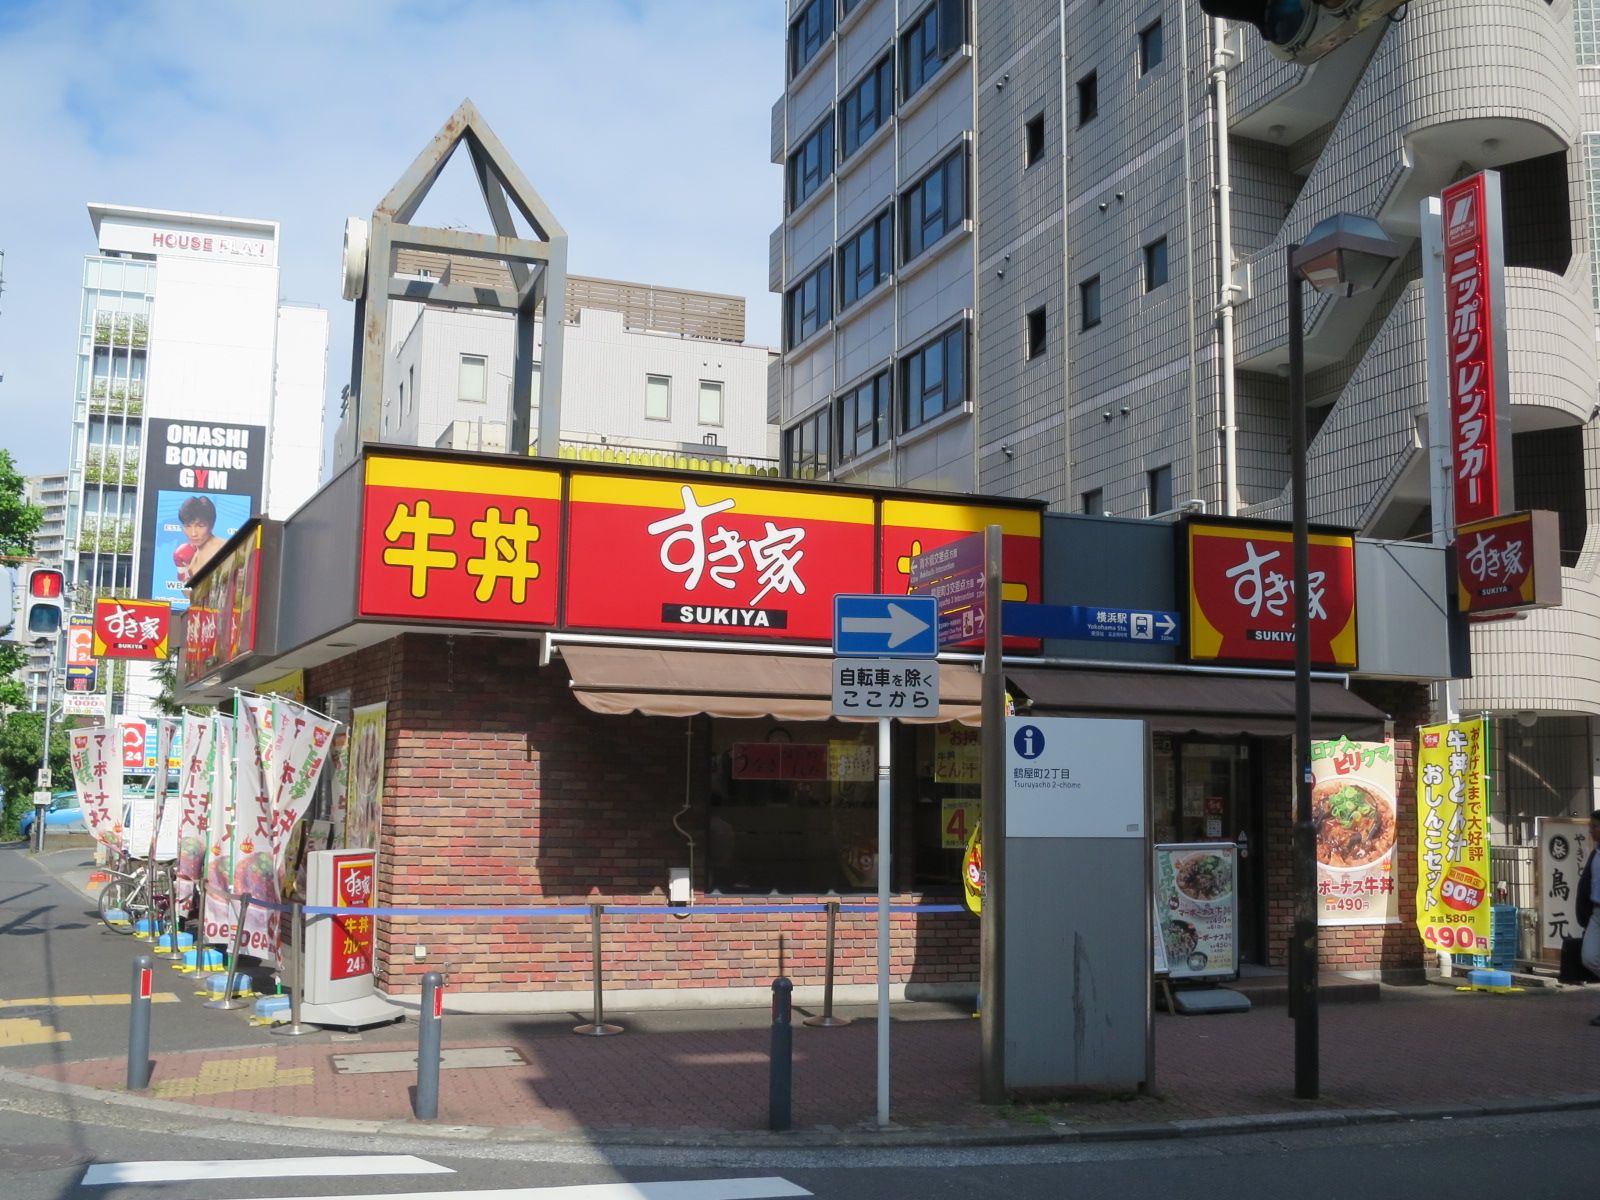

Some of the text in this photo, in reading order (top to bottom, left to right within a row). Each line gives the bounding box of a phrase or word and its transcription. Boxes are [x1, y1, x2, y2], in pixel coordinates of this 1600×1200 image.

[152, 233, 213, 252] HOUSE
[1451, 249, 1487, 504] ニッポンレンタカー
[167, 424, 250, 449] OHASHI
[165, 446, 248, 470] BOXING
[179, 468, 228, 490] GYM
[383, 500, 541, 604] 牛丼
[647, 485, 807, 606] すき家
[1465, 533, 1523, 583] すき家
[1482, 586, 1508, 596] SUKIYA
[104, 605, 160, 643] すき家
[679, 606, 770, 627] SUKIYA
[1087, 624, 1116, 632] Yokohama
[1096, 611, 1127, 623] 横浜駅
[841, 667, 933, 688] 自転車を除く
[843, 690, 930, 709] ここから
[125, 751, 142, 761] 24
[94, 735, 111, 821] マーボーナス
[1014, 768, 1070, 779] 鶴屋町2丁目
[1446, 730, 1469, 862] 牛丼とん汁
[1467, 727, 1484, 862] おかげさまで大好評
[1423, 763, 1444, 912] おしんこセット
[1574, 833, 1586, 877] やきと
[345, 868, 371, 899] すき家
[1317, 876, 1394, 896] ボーナス牛丼
[345, 916, 369, 934] 牛丼
[343, 937, 369, 955] カレー
[1425, 926, 1488, 951] 490円
